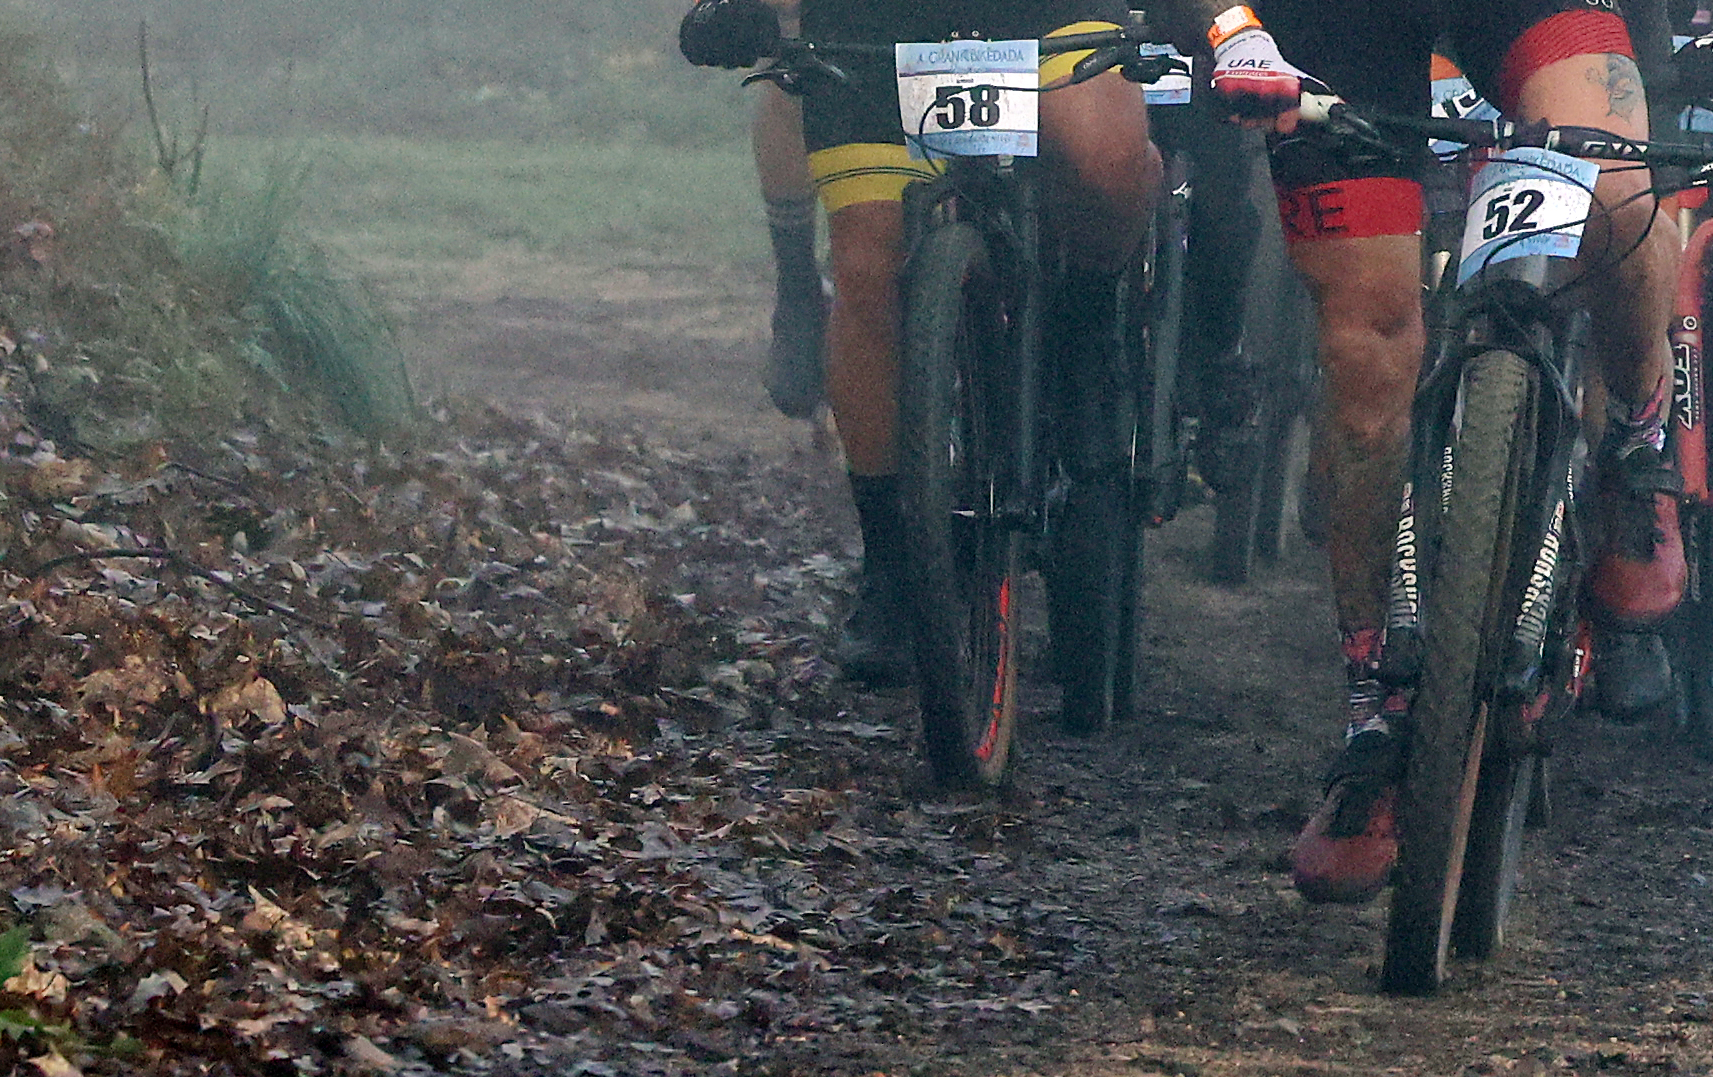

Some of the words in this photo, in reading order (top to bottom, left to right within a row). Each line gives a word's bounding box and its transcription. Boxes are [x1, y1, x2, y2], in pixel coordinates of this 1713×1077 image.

[1227, 58, 1274, 69] UAE
[935, 84, 1001, 129] 58
[1482, 189, 1545, 240] 52
